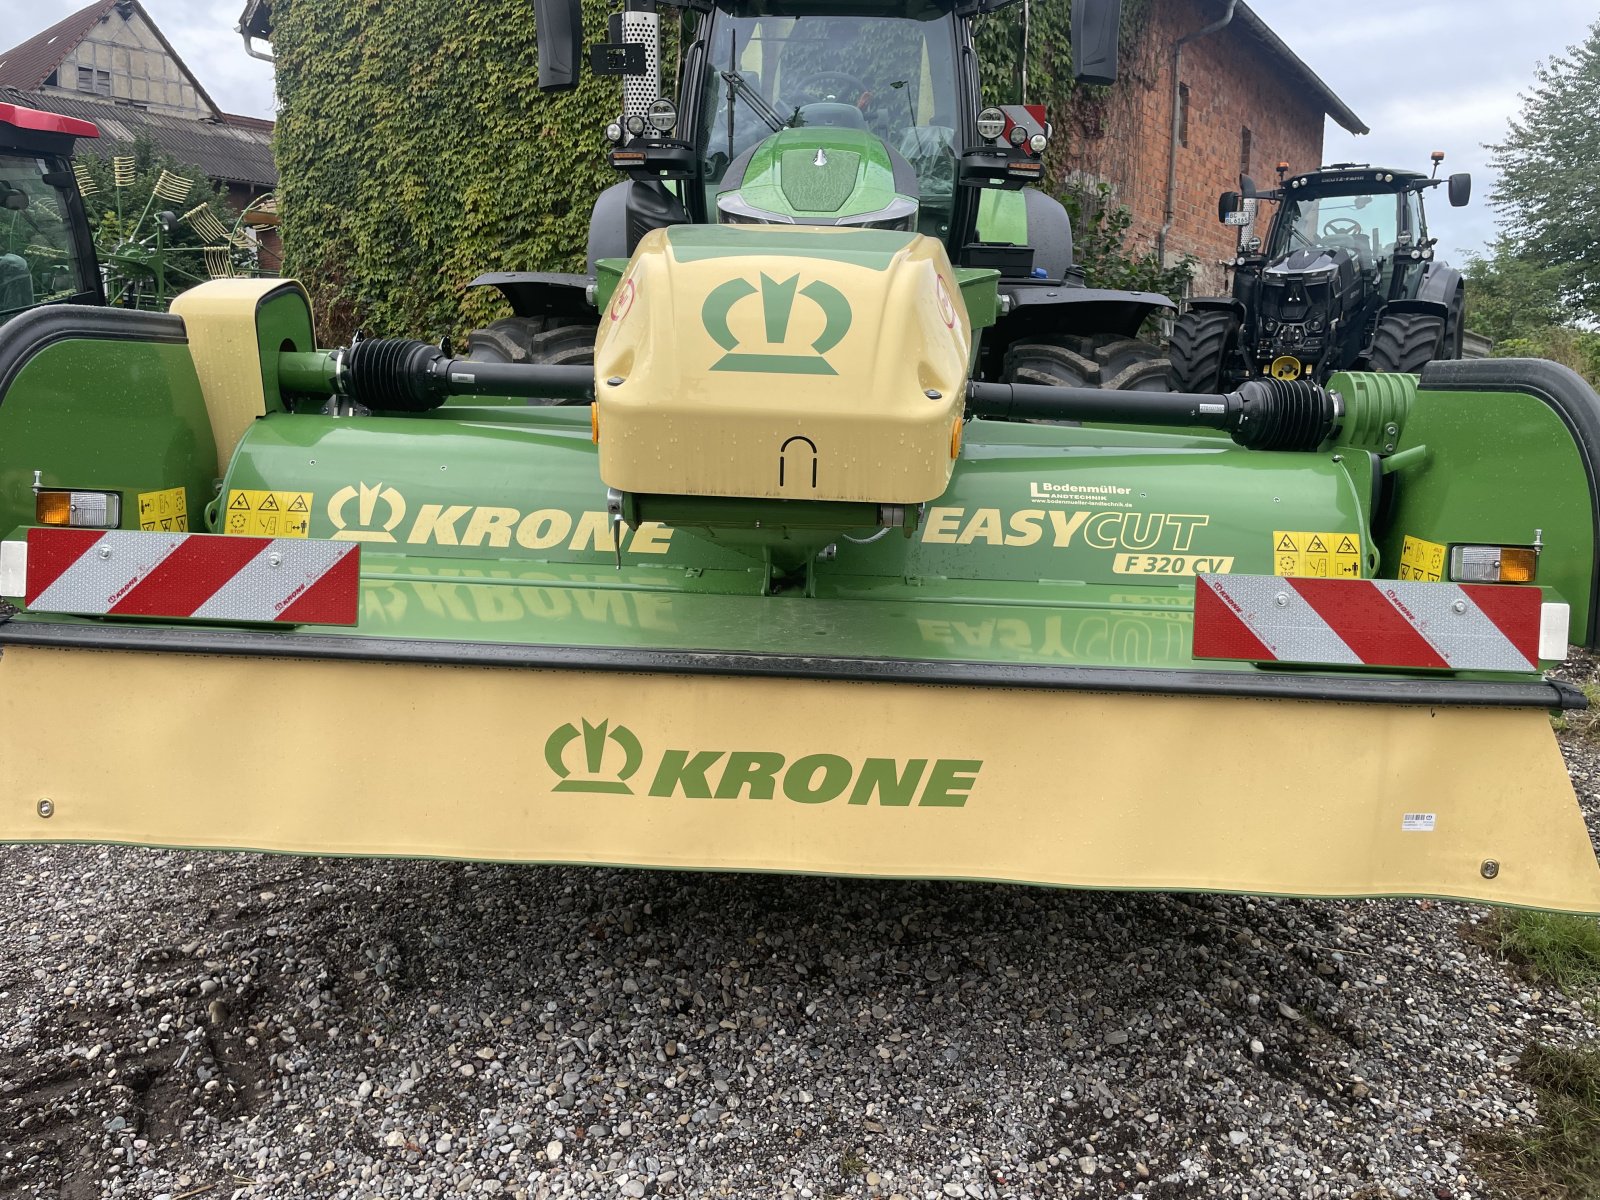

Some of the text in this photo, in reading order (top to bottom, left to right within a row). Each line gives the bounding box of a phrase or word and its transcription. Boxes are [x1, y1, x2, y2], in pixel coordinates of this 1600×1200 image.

[1031, 498, 1133, 508] www.bodenmueller-landtechnik.de
[1043, 482, 1132, 495] Bodenmüller
[406, 504, 675, 554] KRONE
[921, 506, 1210, 551] EASYCUT
[1124, 557, 1225, 575] F 320 CV
[648, 749, 984, 808] KRONE
